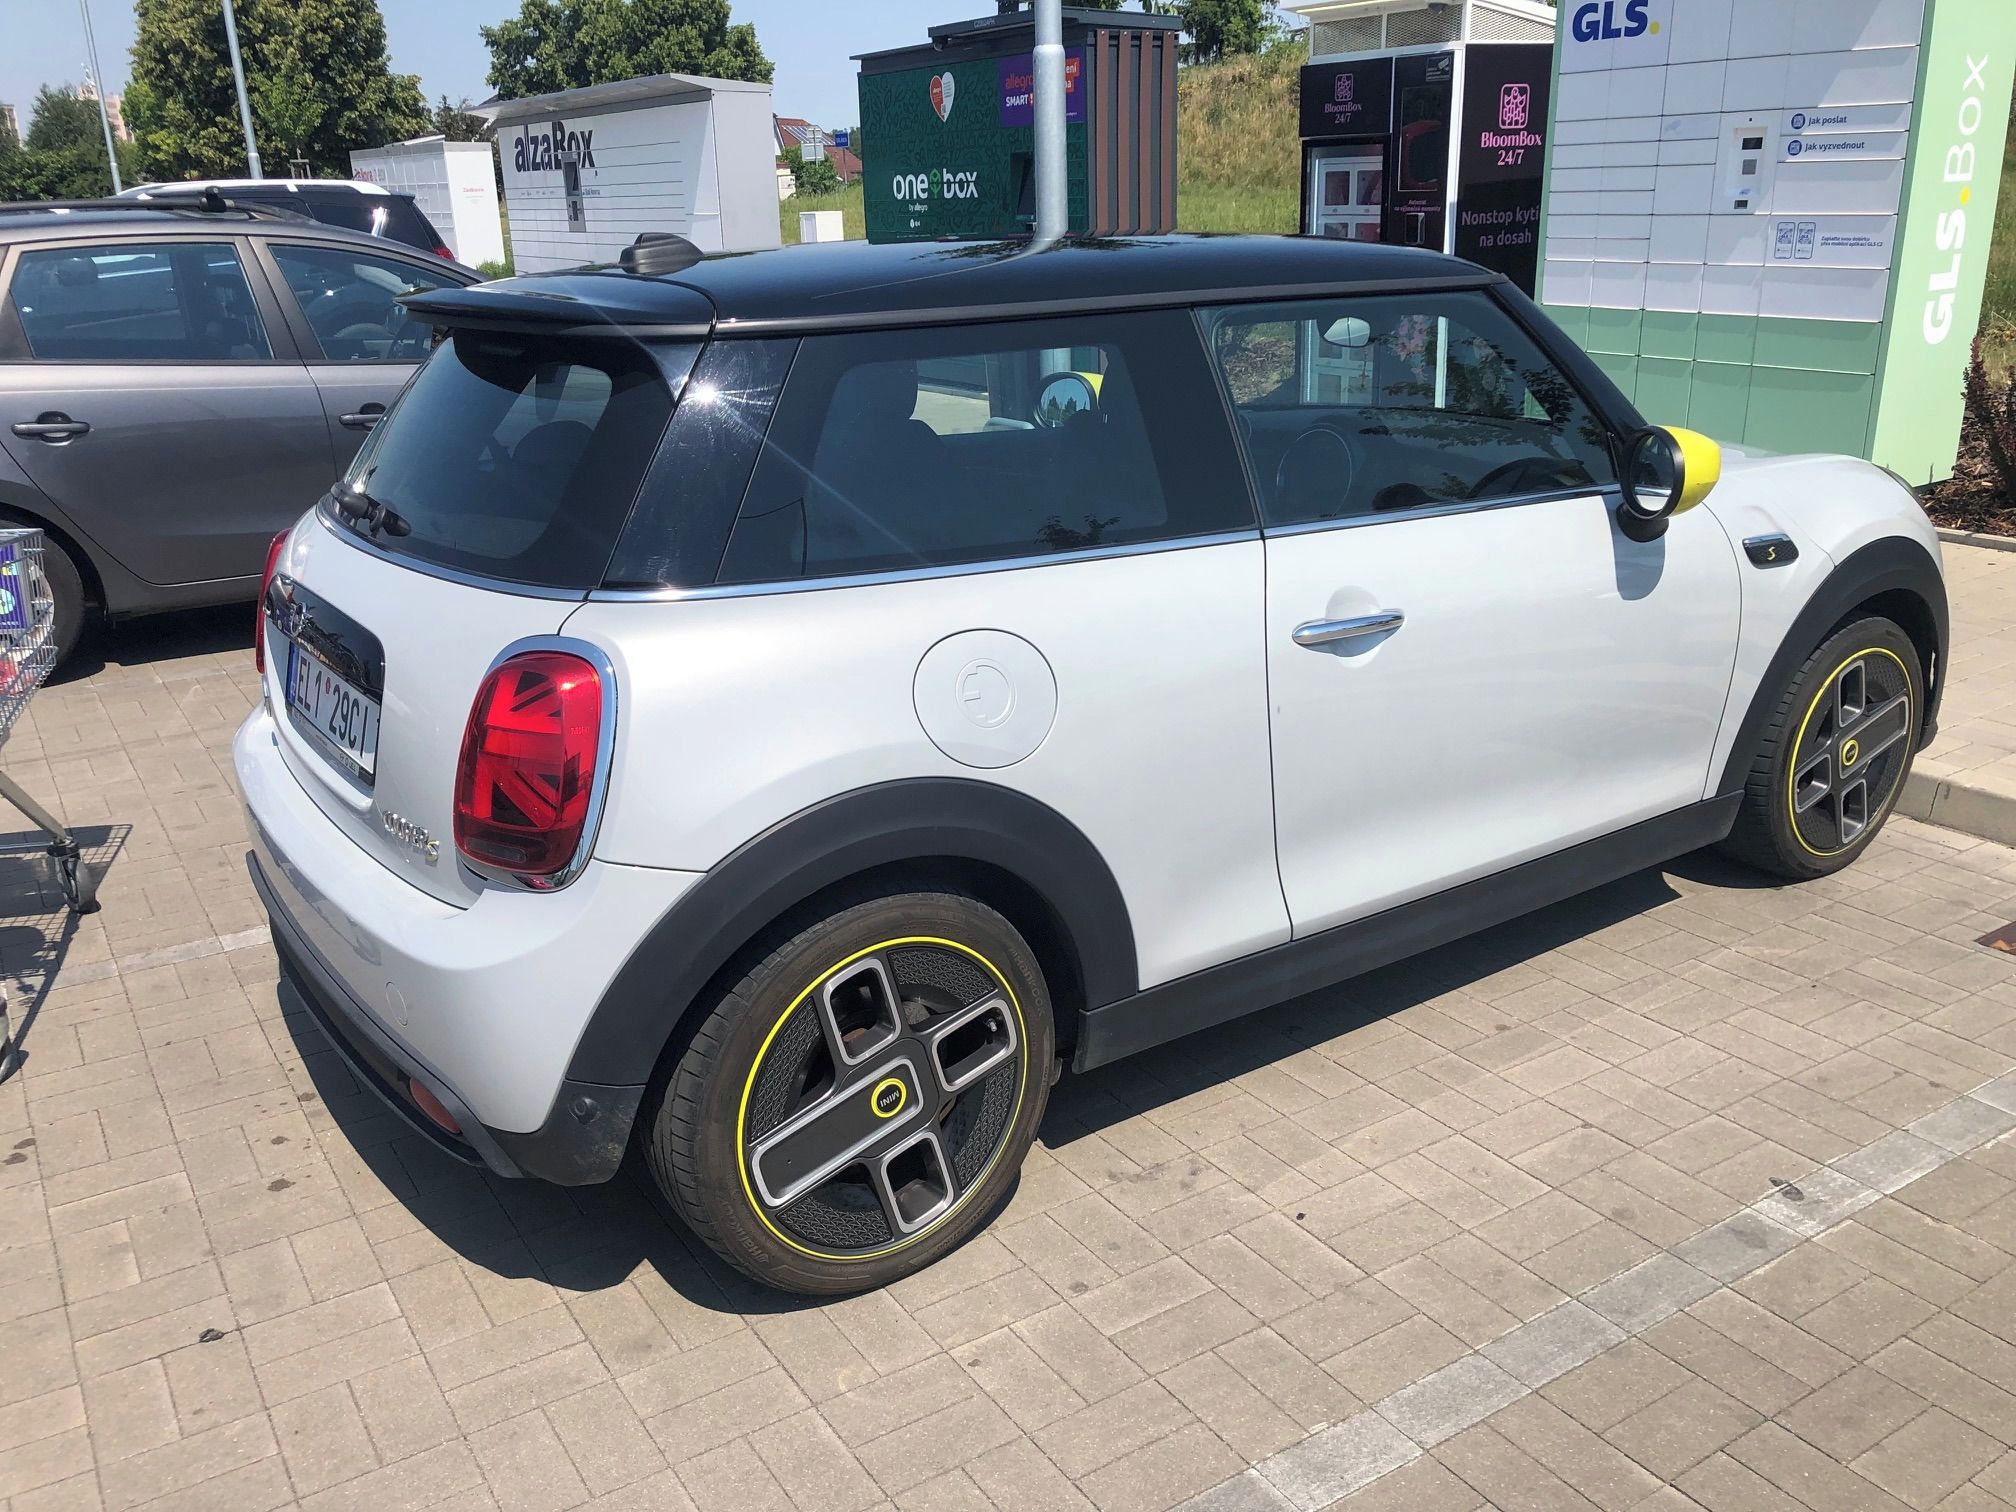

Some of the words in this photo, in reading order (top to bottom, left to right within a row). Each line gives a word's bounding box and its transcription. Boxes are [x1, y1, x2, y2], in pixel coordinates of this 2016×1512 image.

[1325, 101, 1362, 112] BloomBox
[1335, 113, 1351, 124] 24/7
[1808, 116, 1821, 126] Jak
[1822, 115, 1847, 126] poslat
[514, 121, 595, 172] alzaBox
[1481, 130, 1542, 148] BloomBox
[1805, 143, 1818, 152] Jak
[1819, 141, 1865, 152] vyzvednout
[1497, 149, 1524, 166] 24/7
[1461, 210, 1513, 226] Nonstop
[1480, 234, 1494, 247] na
[1497, 228, 1531, 246] dosah
[1767, 546, 1776, 560] S
[297, 657, 322, 718] EL1
[329, 684, 368, 758] 29CI
[880, 1090, 900, 1107] MINI
